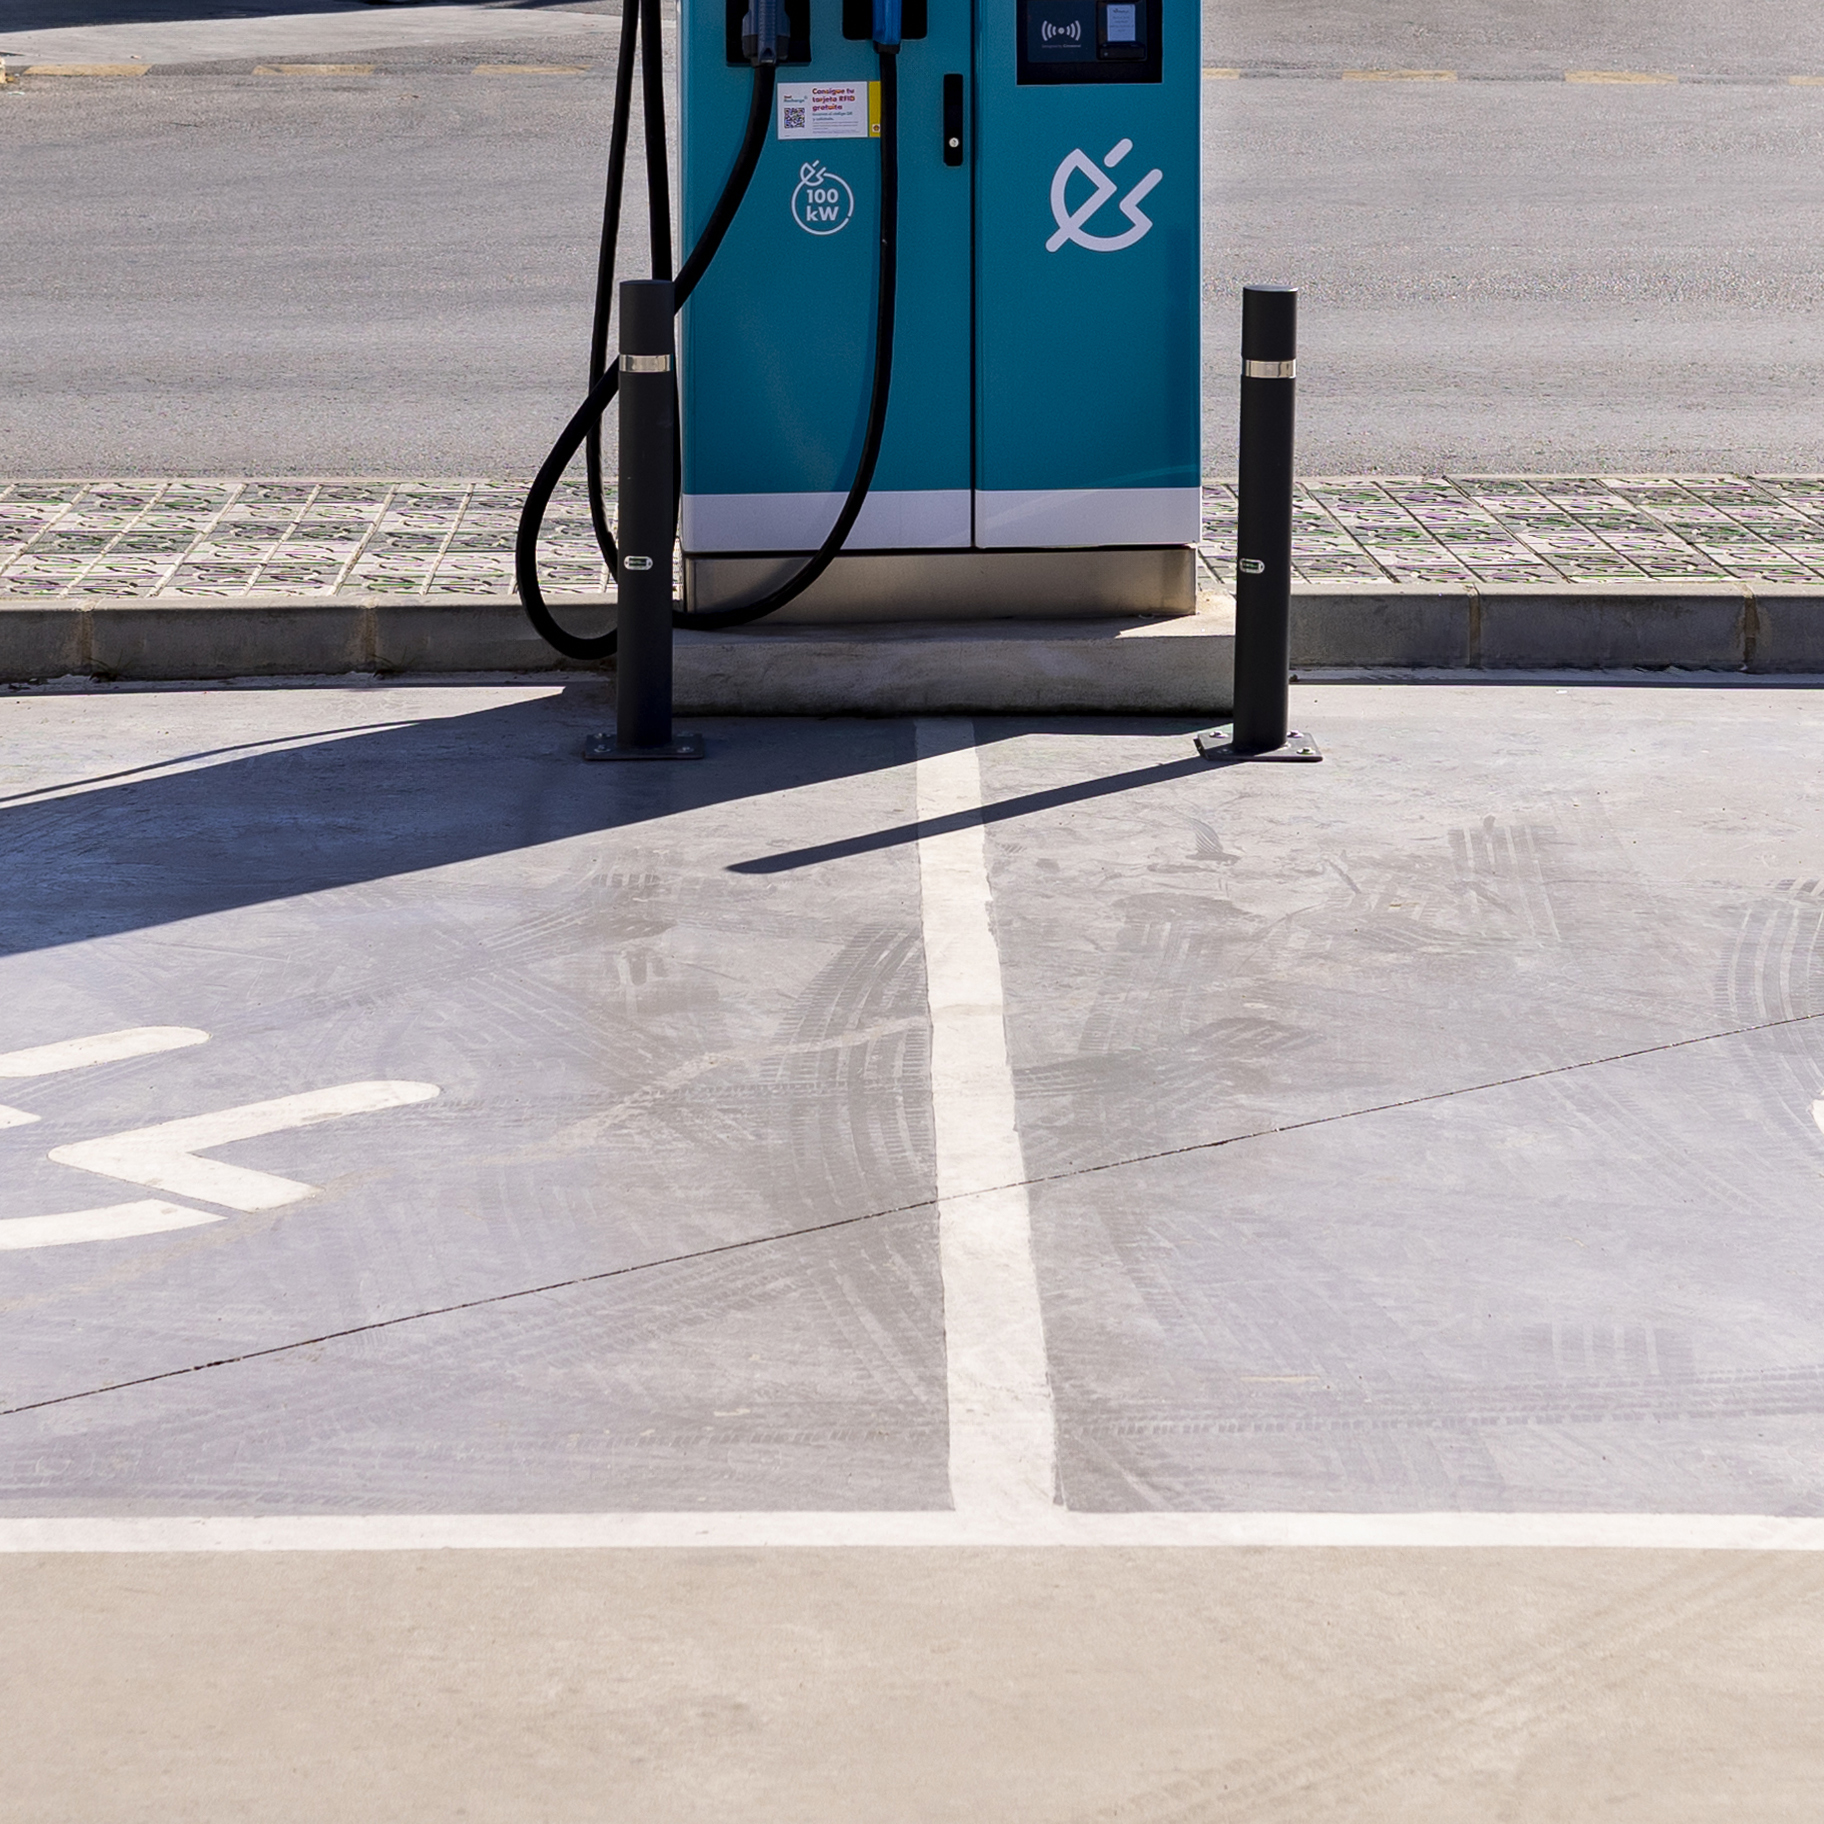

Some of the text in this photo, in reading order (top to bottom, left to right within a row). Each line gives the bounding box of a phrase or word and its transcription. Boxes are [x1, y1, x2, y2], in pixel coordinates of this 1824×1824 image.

[812, 96, 837, 104] tarjeta
[812, 104, 842, 112] gratuita
[806, 188, 839, 203] 100
[806, 205, 839, 221] kW
